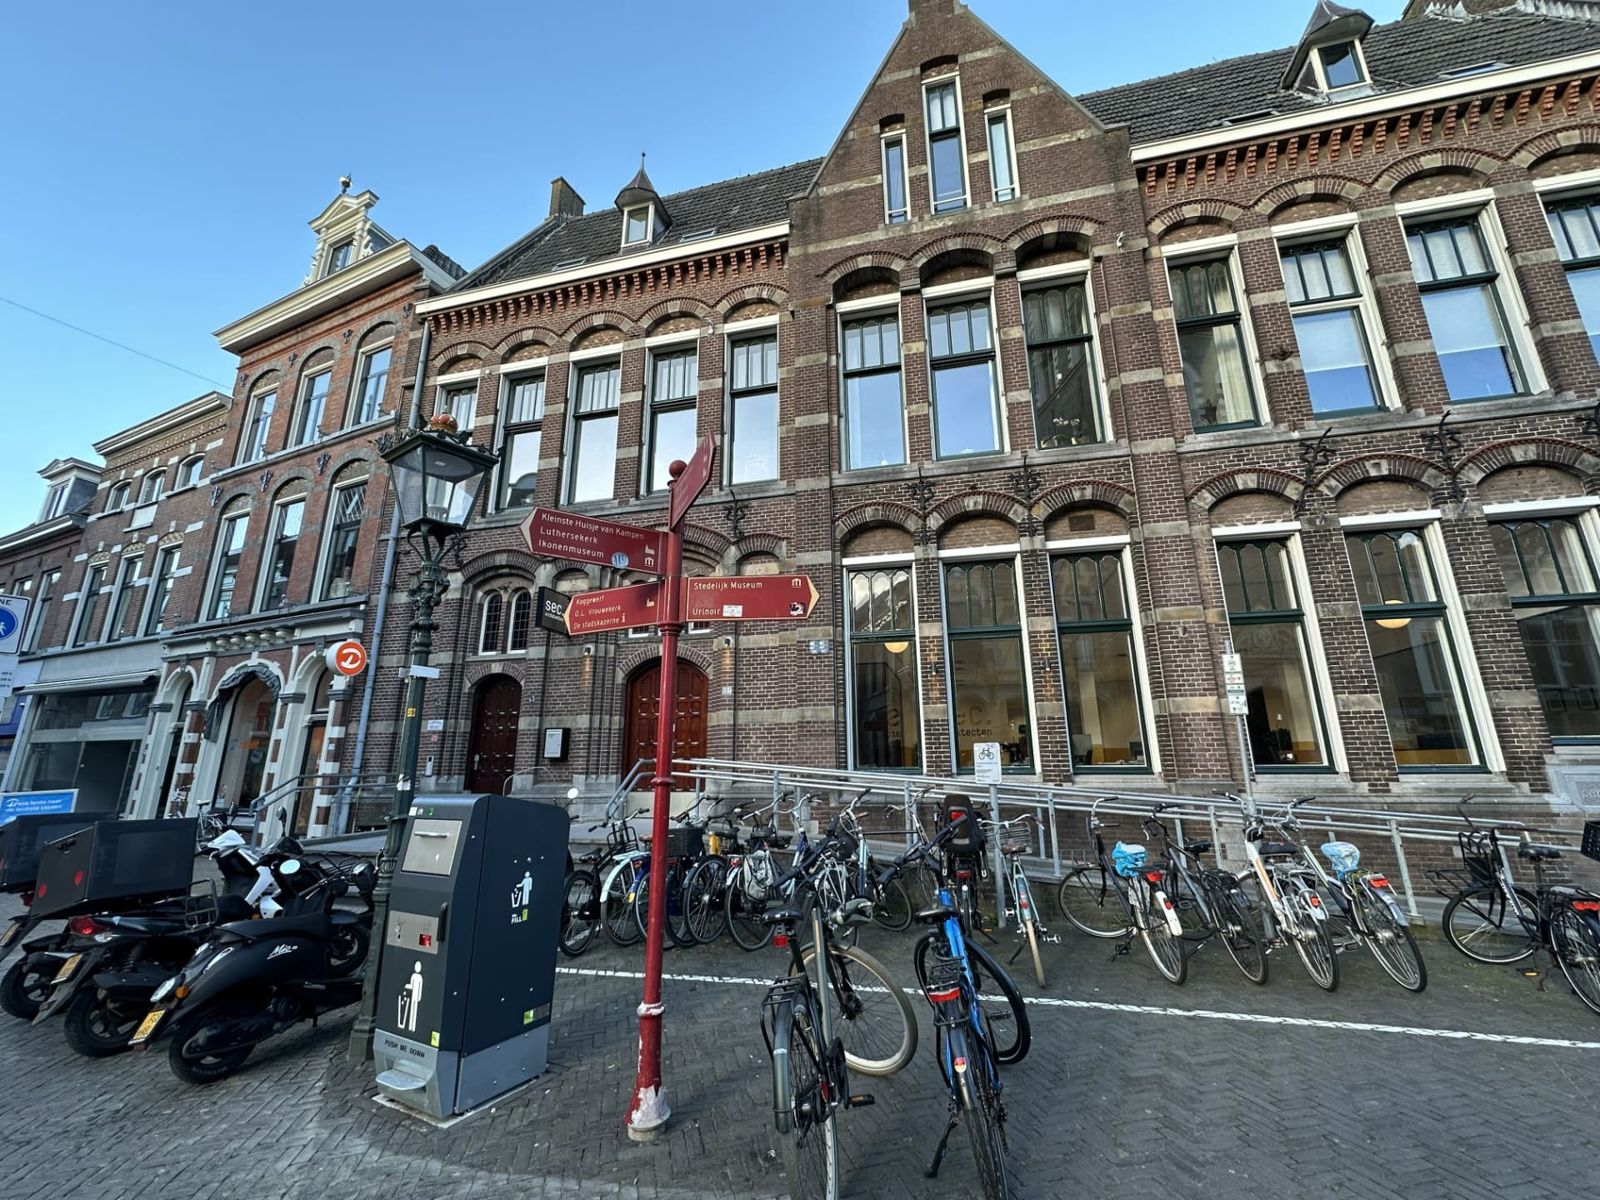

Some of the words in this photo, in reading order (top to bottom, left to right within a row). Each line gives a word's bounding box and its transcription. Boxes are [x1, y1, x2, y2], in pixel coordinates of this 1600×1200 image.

[540, 526, 598, 544] Luthersekerk
[541, 512, 574, 526] Kleinste
[575, 519, 599, 532] Huisje
[601, 525, 614, 534] van
[615, 528, 644, 540] Kampen
[538, 539, 604, 558] Ikonenmuseum
[693, 582, 728, 591] Stedelijk
[730, 581, 763, 589] Museum
[0, 598, 12, 606] NE
[692, 607, 720, 616] Urinoir
[384, 1039, 398, 1049] PUSH
[400, 1043, 407, 1052] ME
[409, 1047, 425, 1058] DOWN
